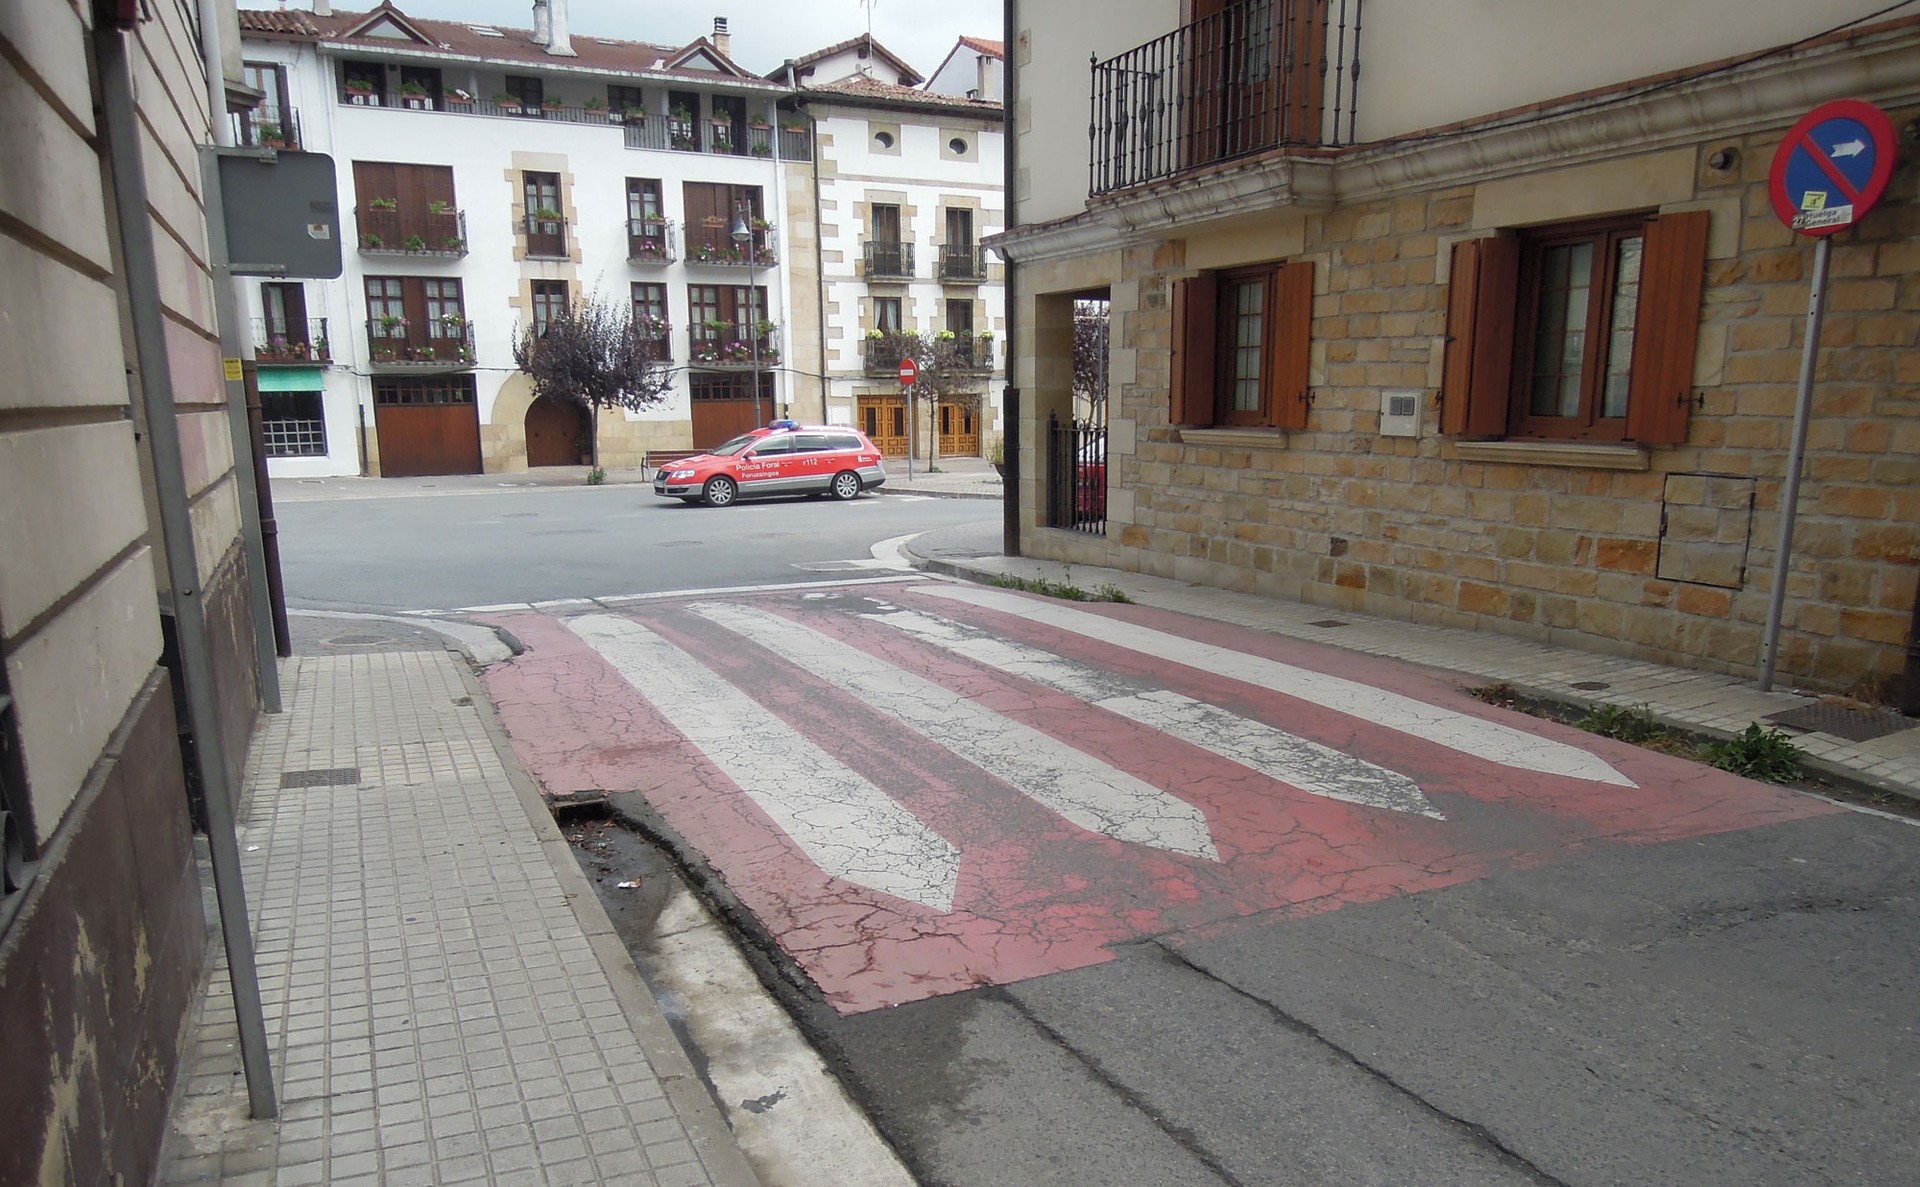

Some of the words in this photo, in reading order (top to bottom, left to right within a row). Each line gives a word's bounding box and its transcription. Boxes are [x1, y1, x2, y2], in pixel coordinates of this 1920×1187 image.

[1807, 210, 1837, 218] Huelga
[1806, 216, 1840, 227] General
[761, 460, 780, 469] Foral
